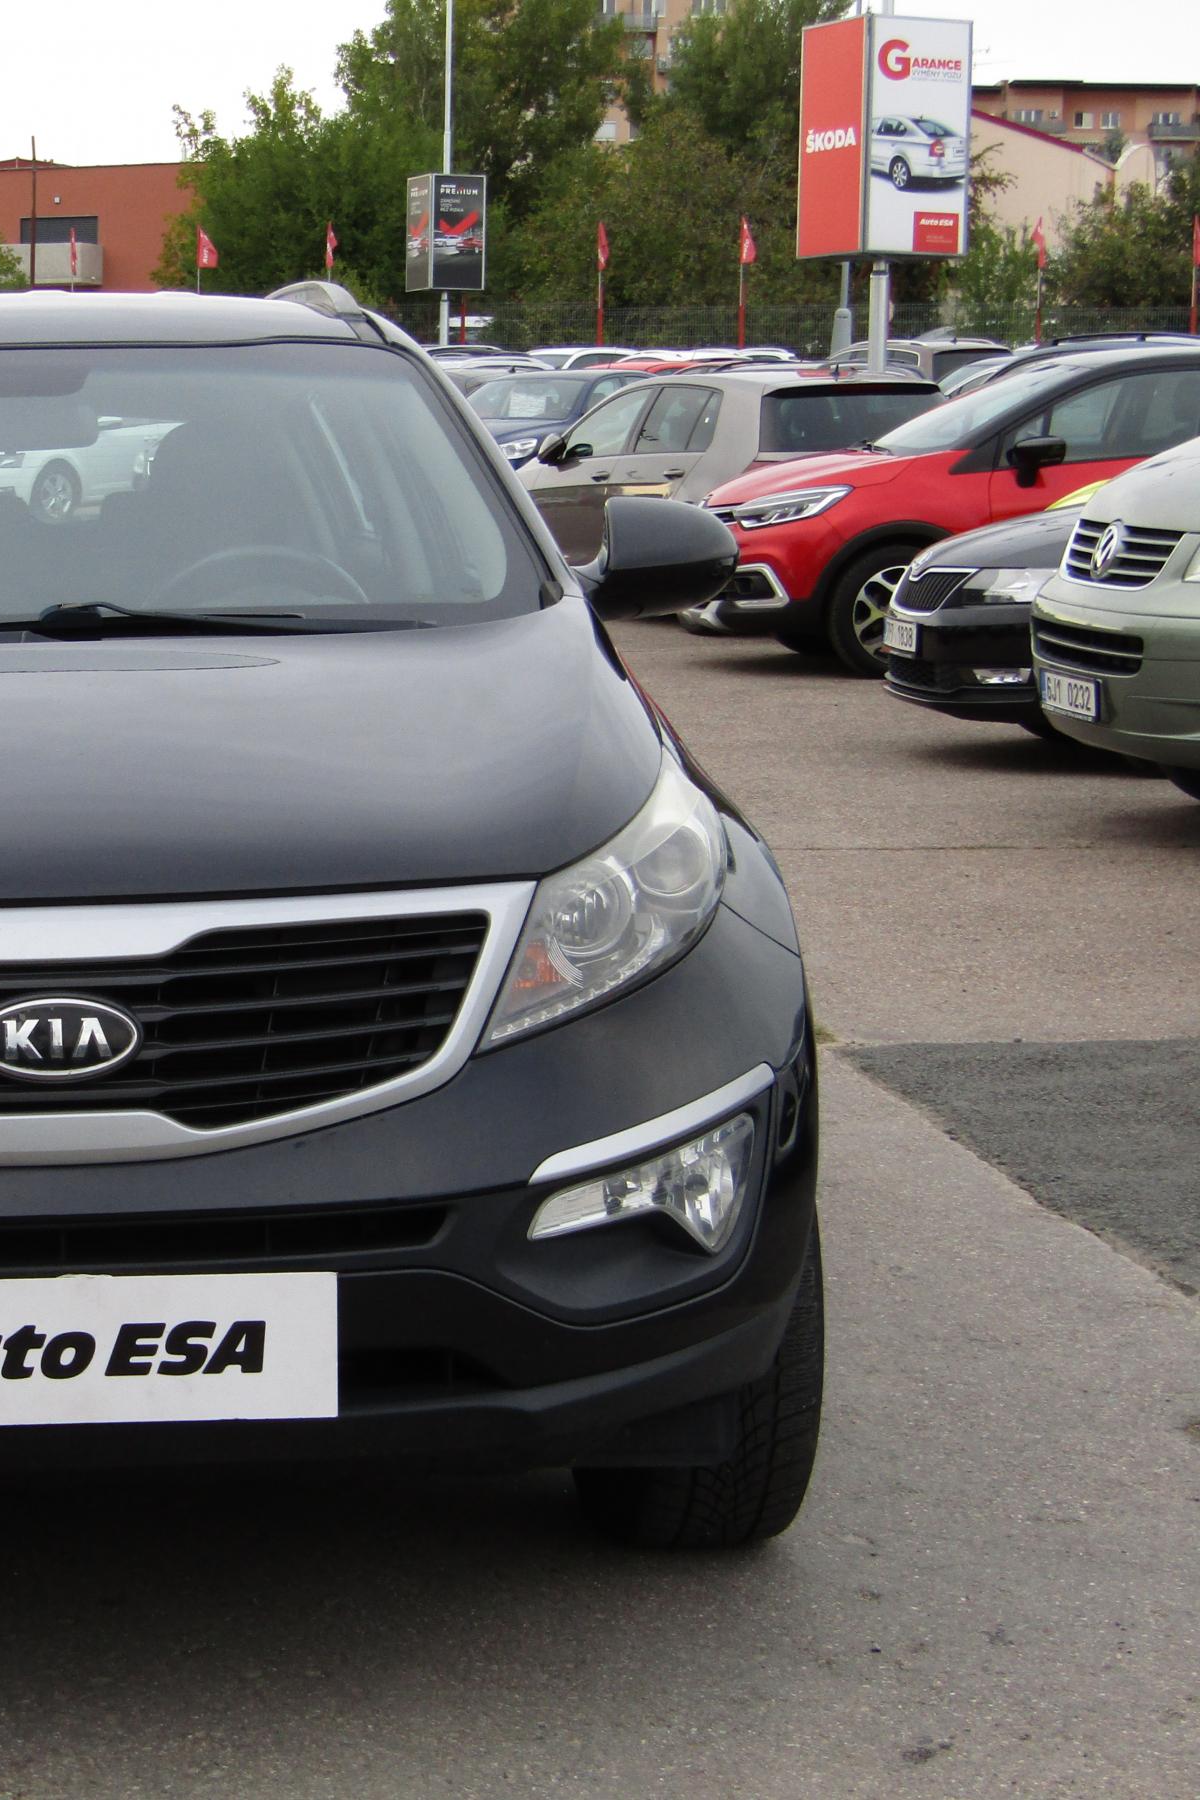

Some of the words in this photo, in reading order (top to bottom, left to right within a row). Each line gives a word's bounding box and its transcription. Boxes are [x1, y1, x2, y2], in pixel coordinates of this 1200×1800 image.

[878, 39, 962, 81] GARANCE
[806, 127, 857, 153] ŠKODA
[1046, 676, 1061, 705] 6J1
[1067, 681, 1091, 712] 0232
[2, 1017, 113, 1060] KIA
[104, 1320, 267, 1377] ESA
